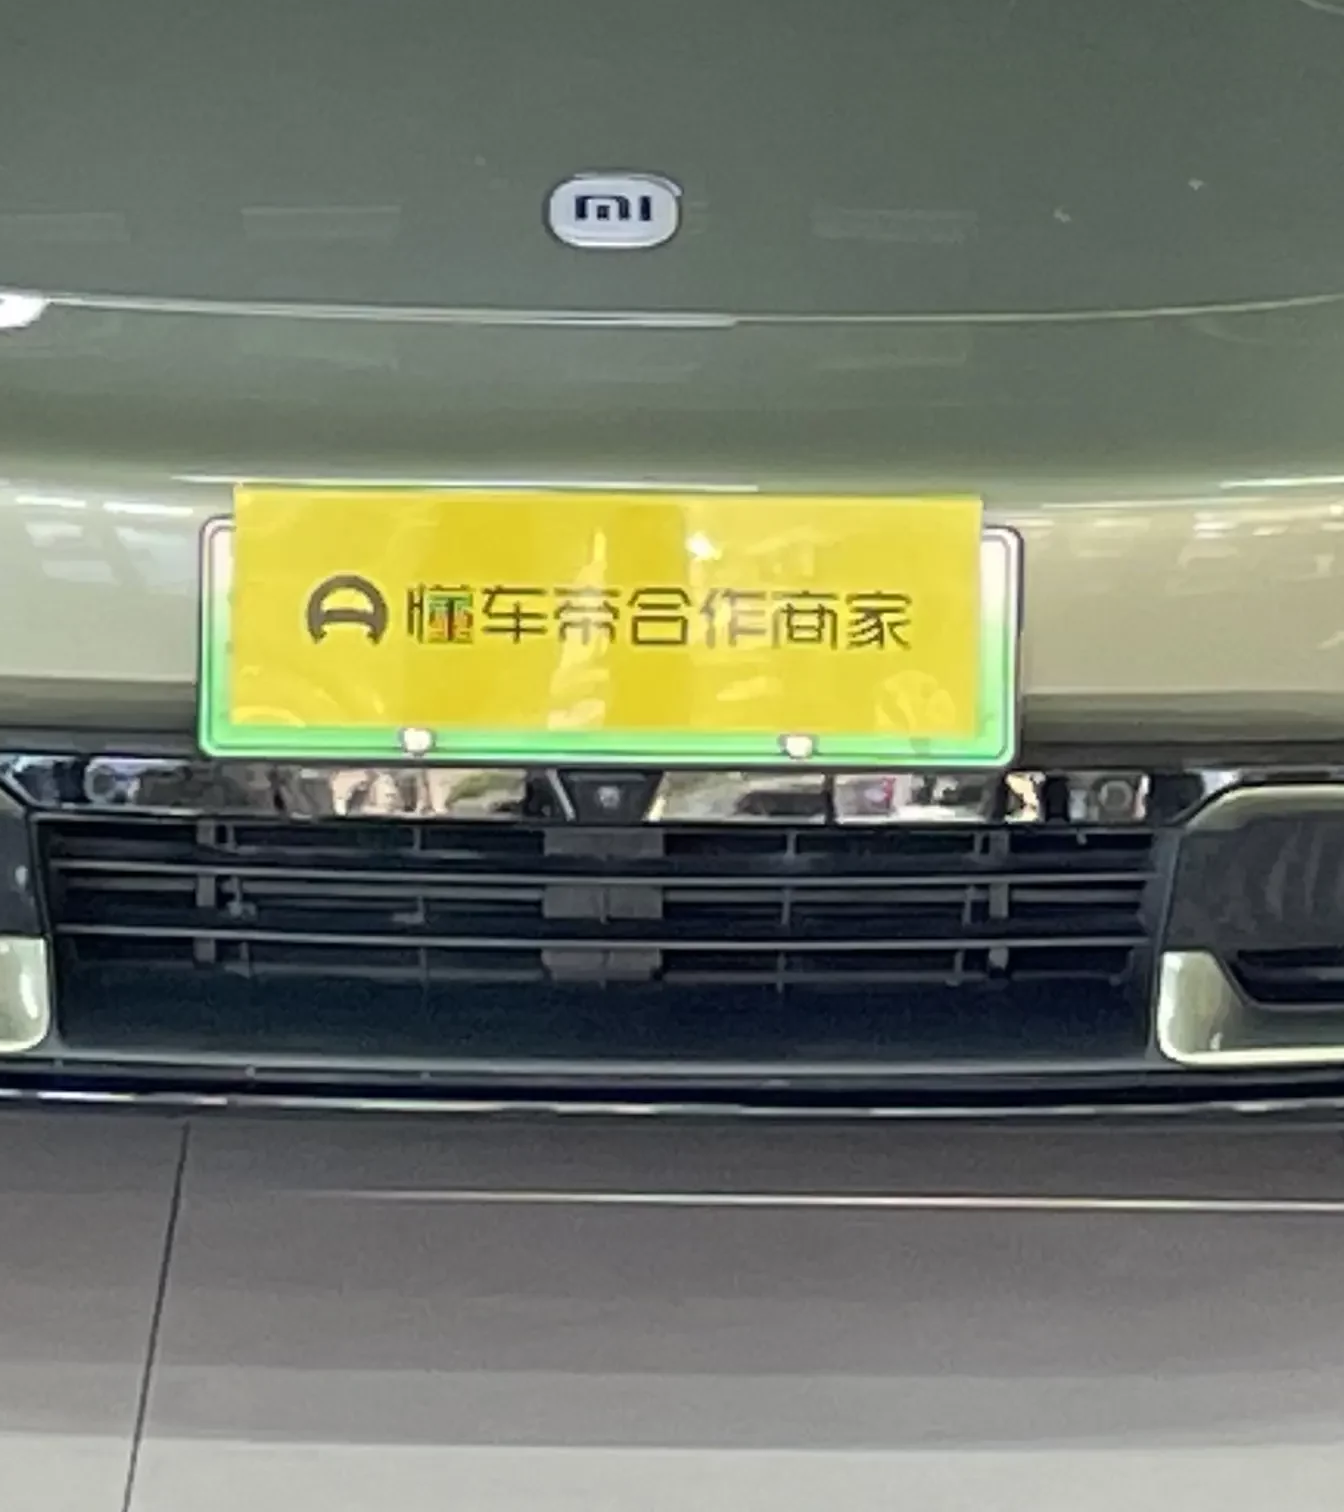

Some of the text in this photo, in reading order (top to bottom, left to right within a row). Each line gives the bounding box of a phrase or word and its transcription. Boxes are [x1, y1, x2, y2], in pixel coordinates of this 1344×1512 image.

[404, 582, 914, 652] 懂车帝合作商家
